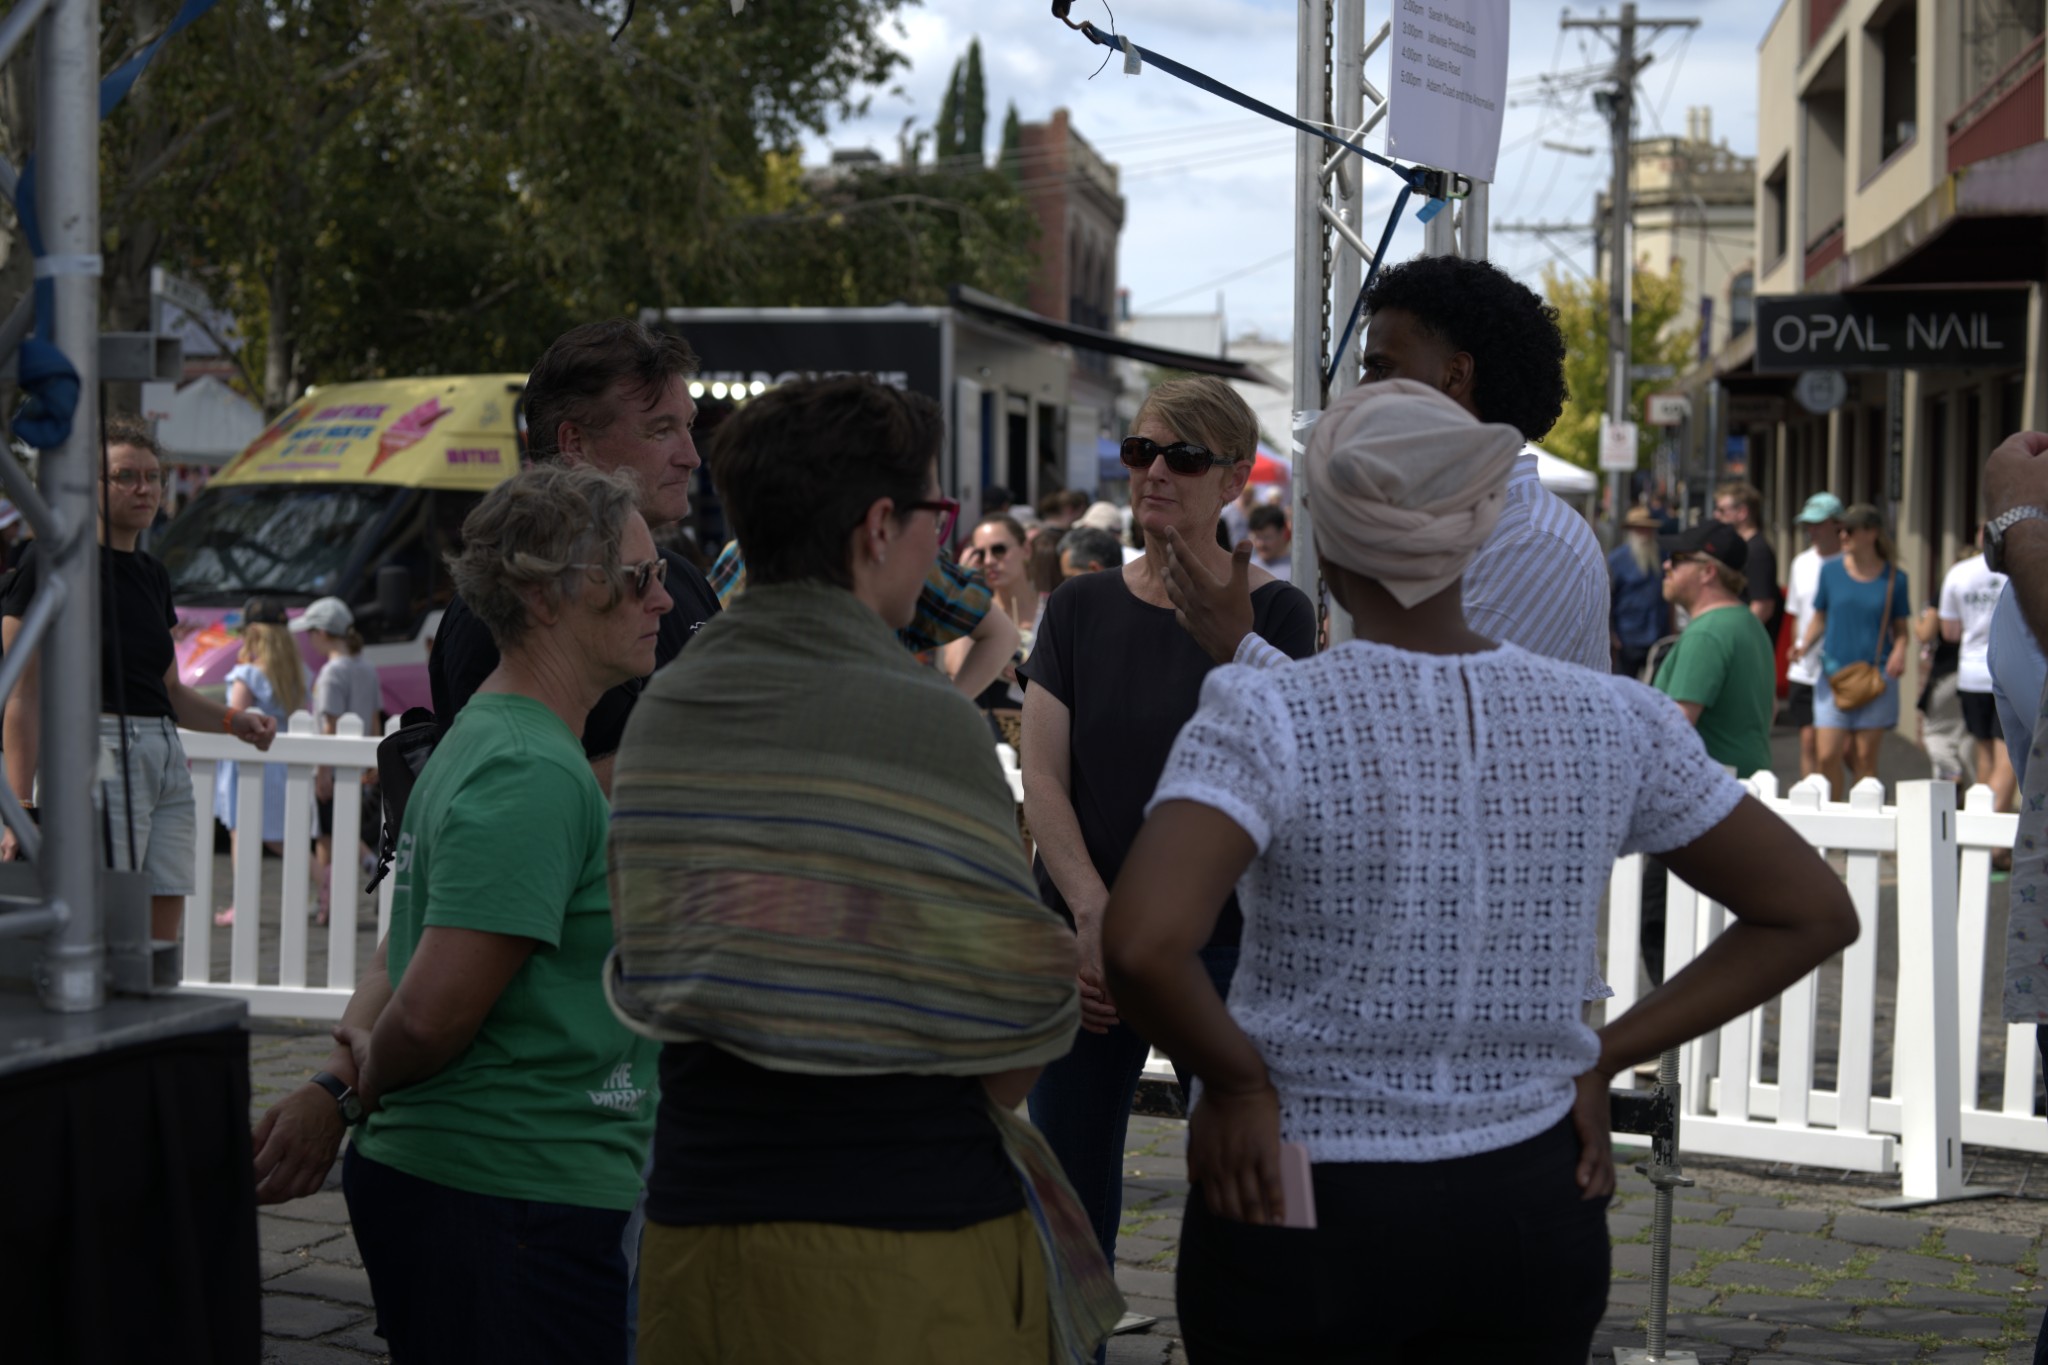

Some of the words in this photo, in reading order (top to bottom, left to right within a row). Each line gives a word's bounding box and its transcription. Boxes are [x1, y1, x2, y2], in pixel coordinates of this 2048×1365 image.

[1402, 21, 1423, 39] 3:00pm
[1401, 46, 1422, 63] 4:00pm
[1448, 61, 1460, 76] Road
[1401, 70, 1421, 88] 5:00pm
[1772, 314, 1890, 353] OPAL
[1907, 312, 2004, 351] NAIL
